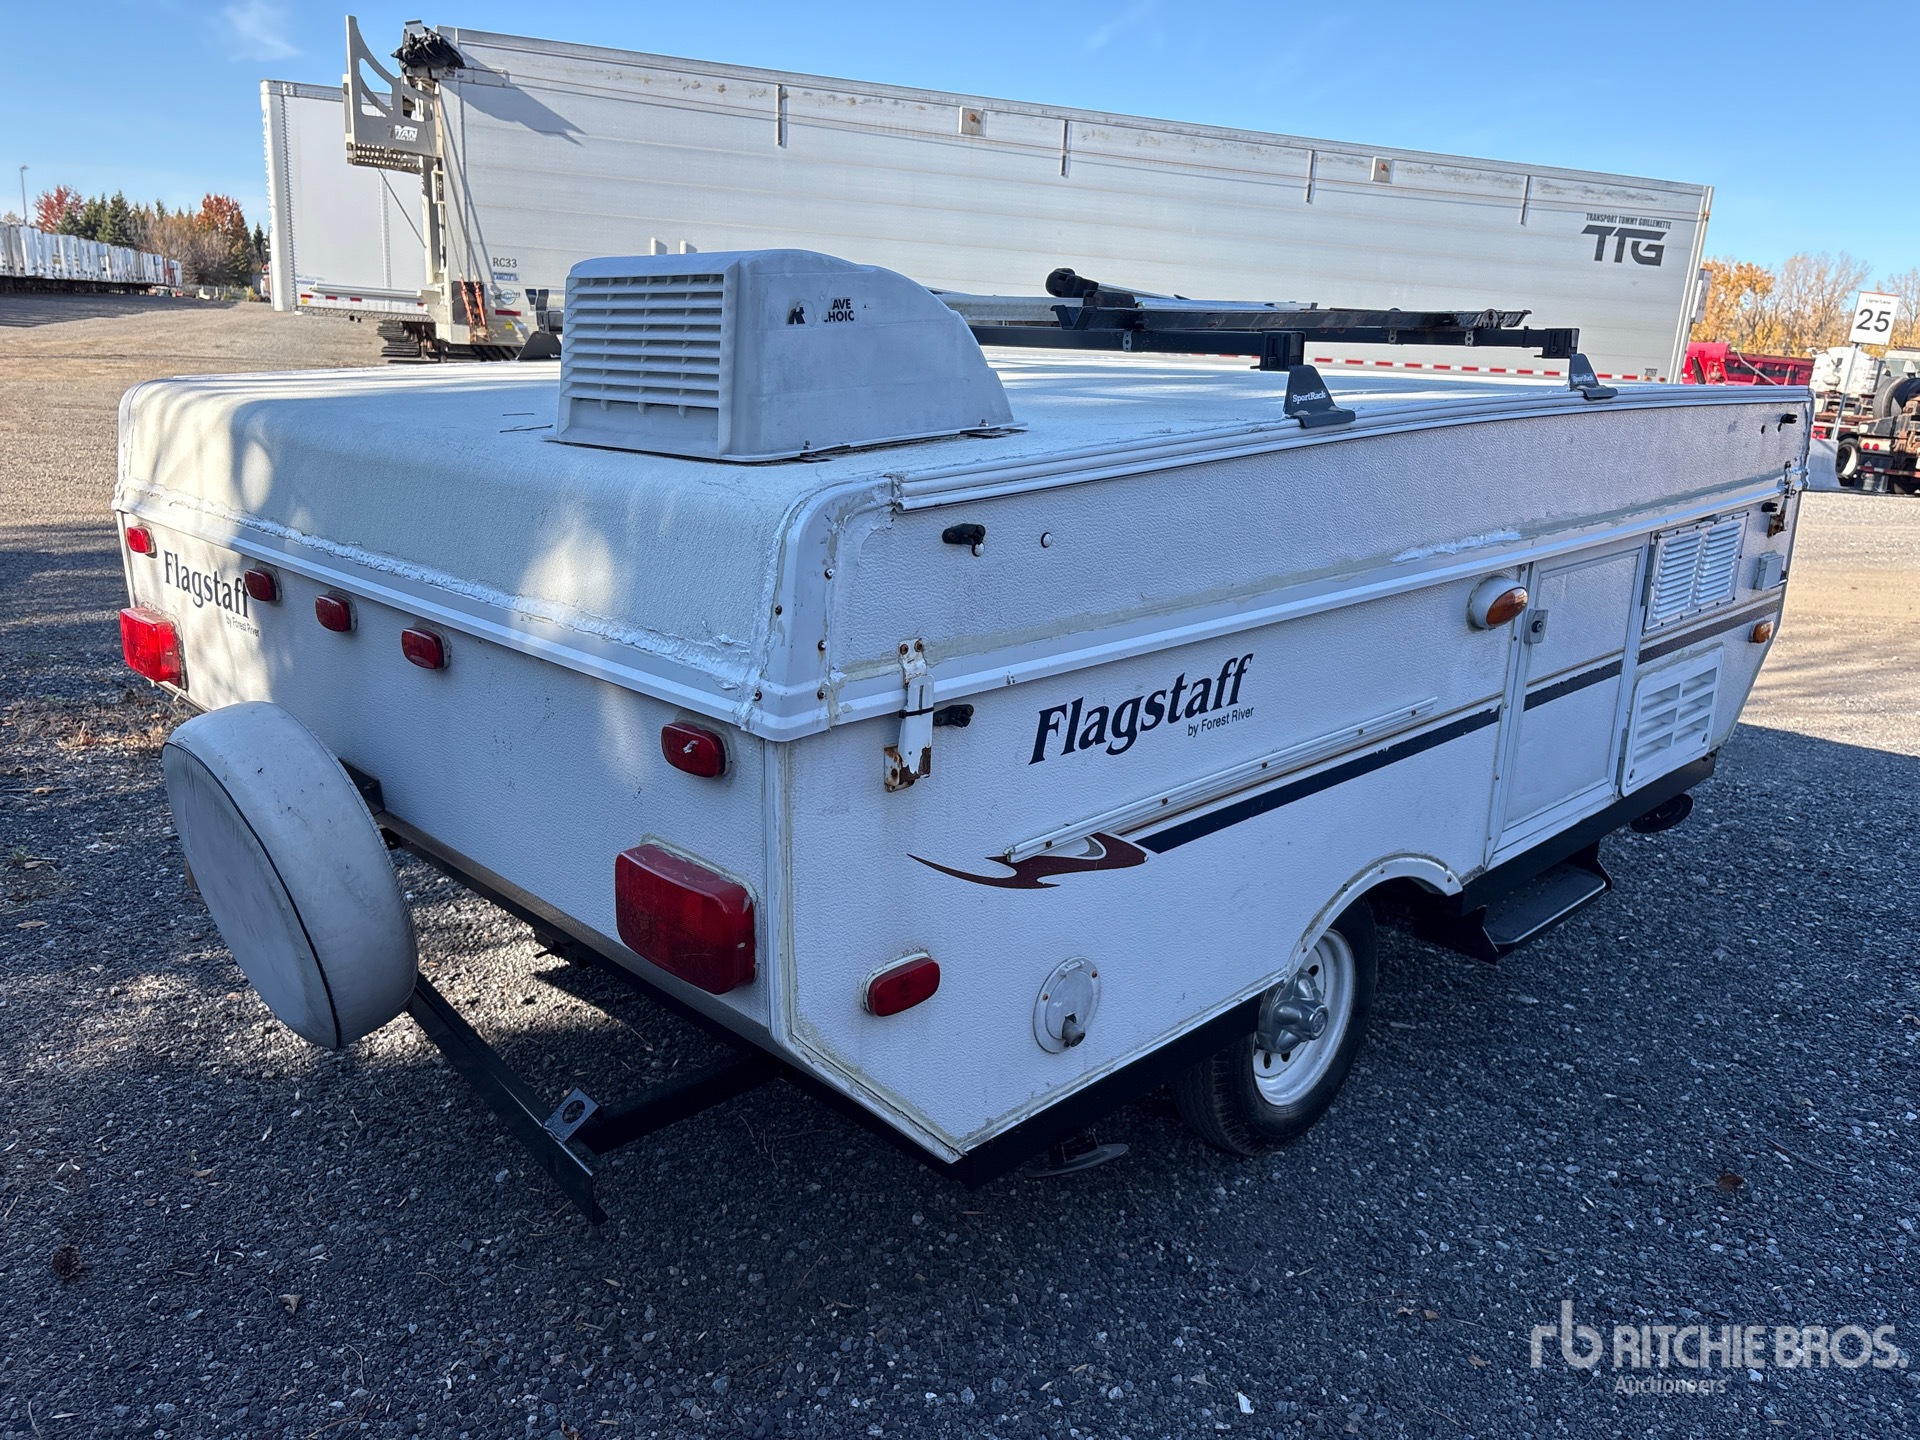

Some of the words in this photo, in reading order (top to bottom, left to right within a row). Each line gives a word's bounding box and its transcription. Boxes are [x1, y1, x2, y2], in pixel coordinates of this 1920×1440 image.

[1586, 213, 1618, 223] TRANSPORT
[1618, 216, 1638, 226] TOMMY
[1581, 225, 1666, 267] TTG
[492, 257, 517, 268] RC33
[1856, 309, 1891, 332] 25
[1292, 390, 1326, 404] SportRack
[163, 550, 249, 619] Flagstaff
[1028, 653, 1254, 766] Flagstaff
[1187, 723, 1199, 737] by
[1201, 714, 1230, 733] Forest
[1231, 707, 1254, 723] River
